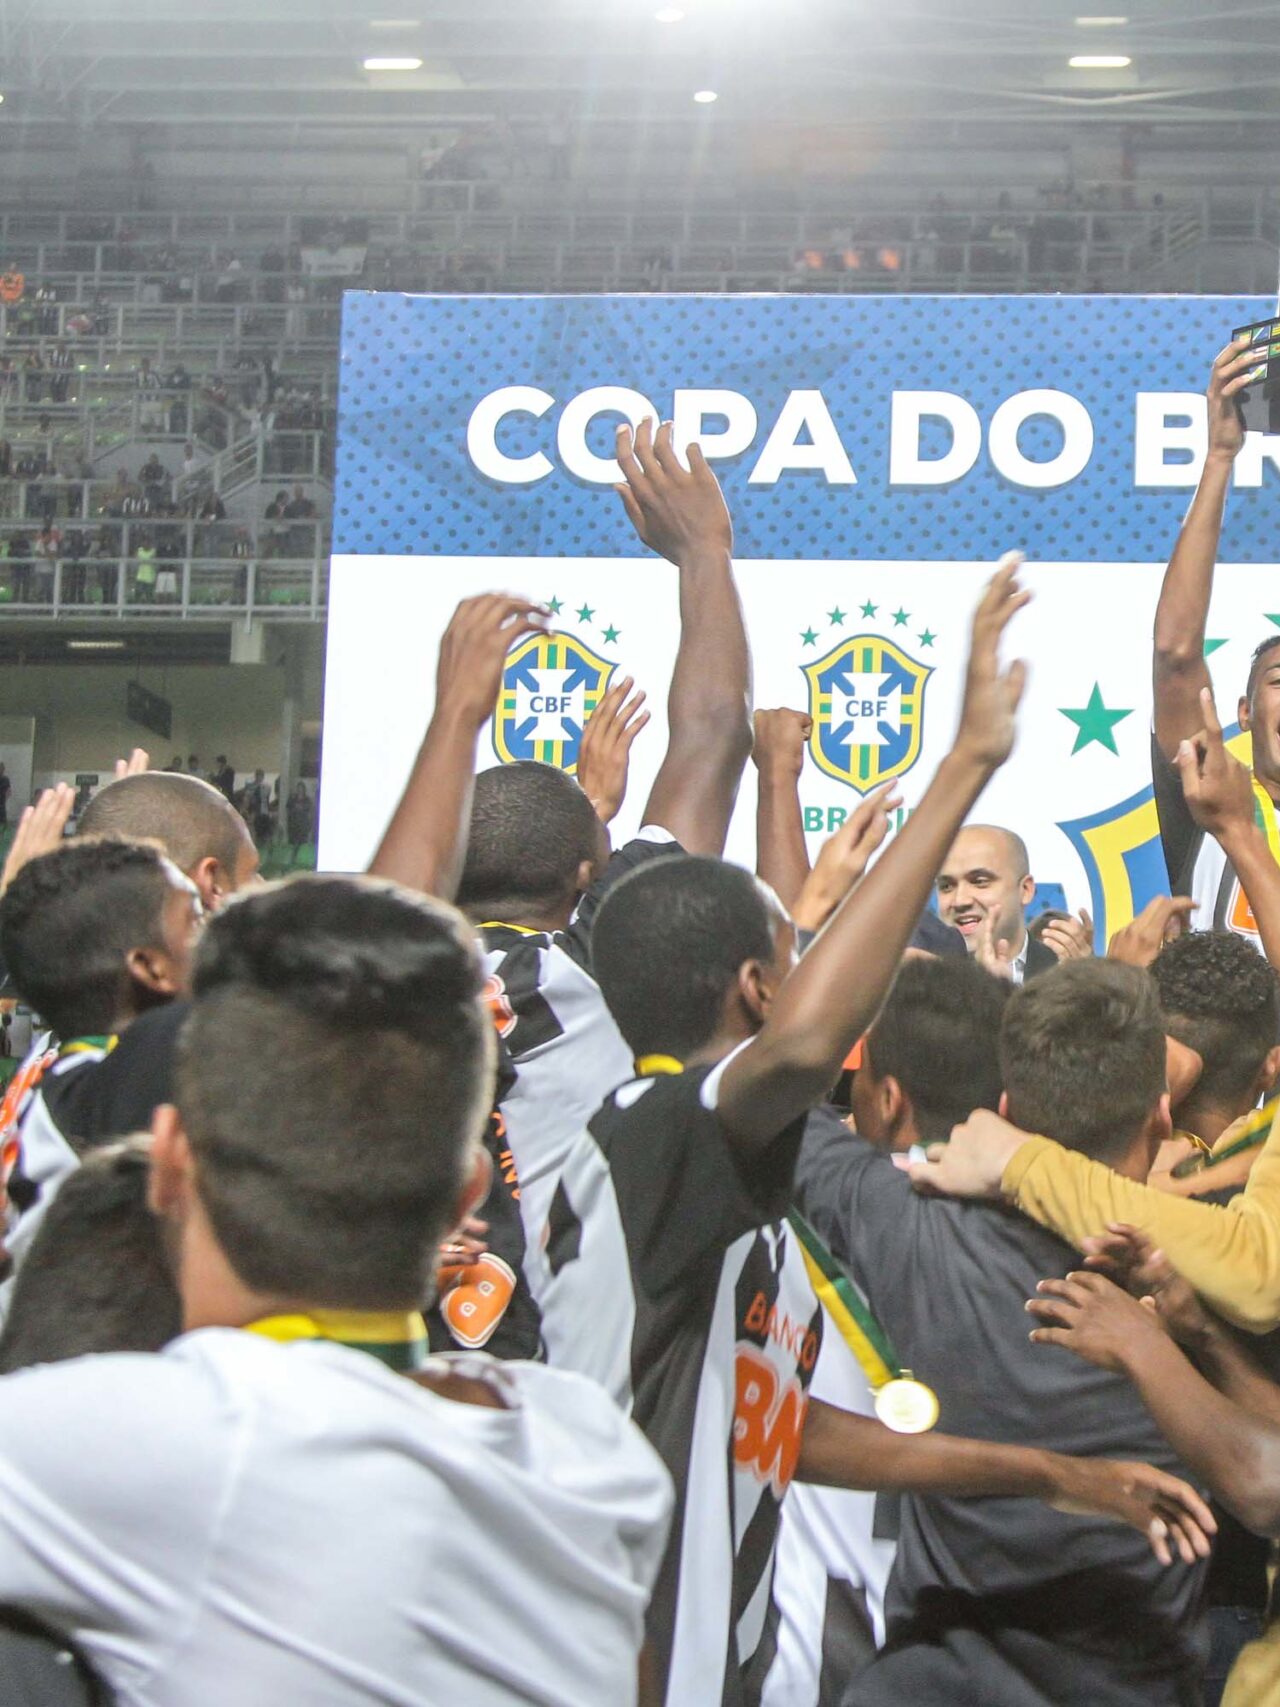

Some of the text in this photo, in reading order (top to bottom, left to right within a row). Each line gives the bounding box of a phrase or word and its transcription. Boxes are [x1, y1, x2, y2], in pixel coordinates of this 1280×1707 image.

[467, 385, 858, 484] COPA
[890, 389, 1093, 488] DO
[530, 696, 572, 713] CBF
[845, 700, 888, 717] CBF
[744, 1290, 818, 1371] BANCO
[734, 1340, 809, 1500] BM
